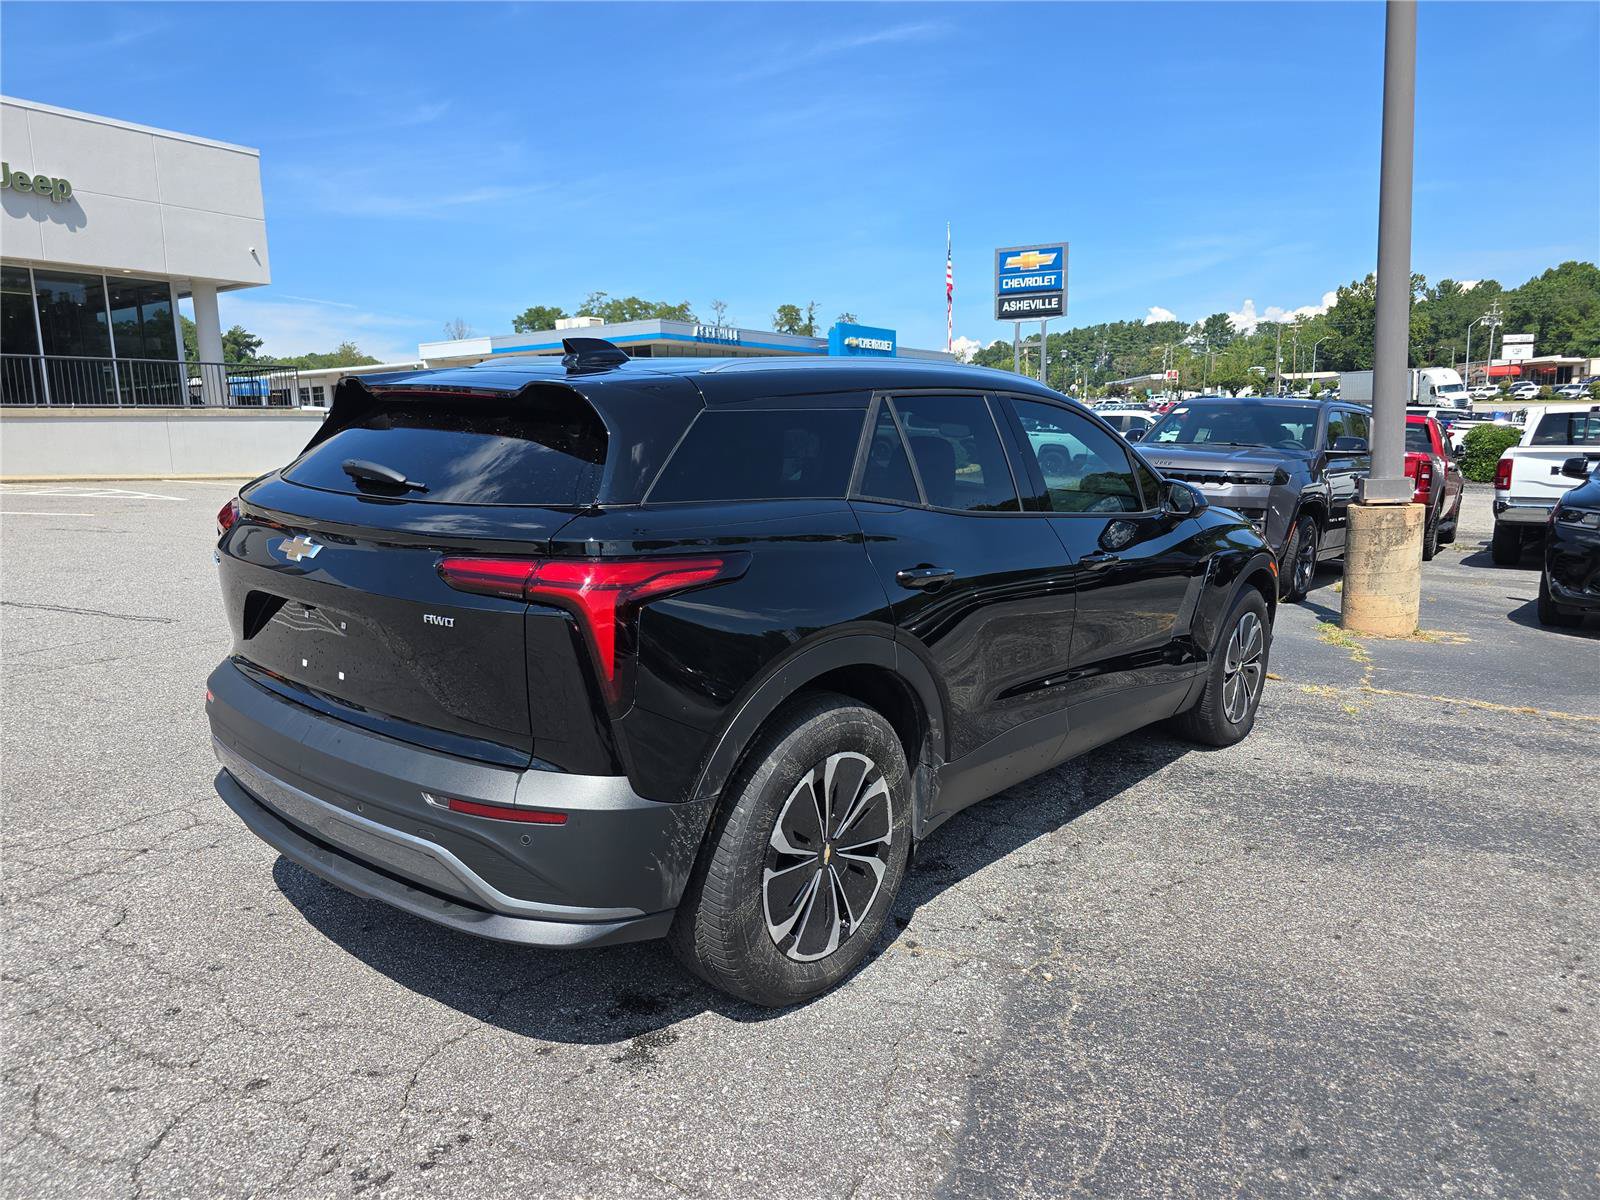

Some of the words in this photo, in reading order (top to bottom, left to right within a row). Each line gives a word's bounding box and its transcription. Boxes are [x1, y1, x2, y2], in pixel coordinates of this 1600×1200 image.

[0, 161, 73, 203] Jeep
[1002, 275, 1057, 289] CHEVROLET
[1002, 298, 1059, 312] ASHEVILLE
[423, 614, 454, 627] AWD
